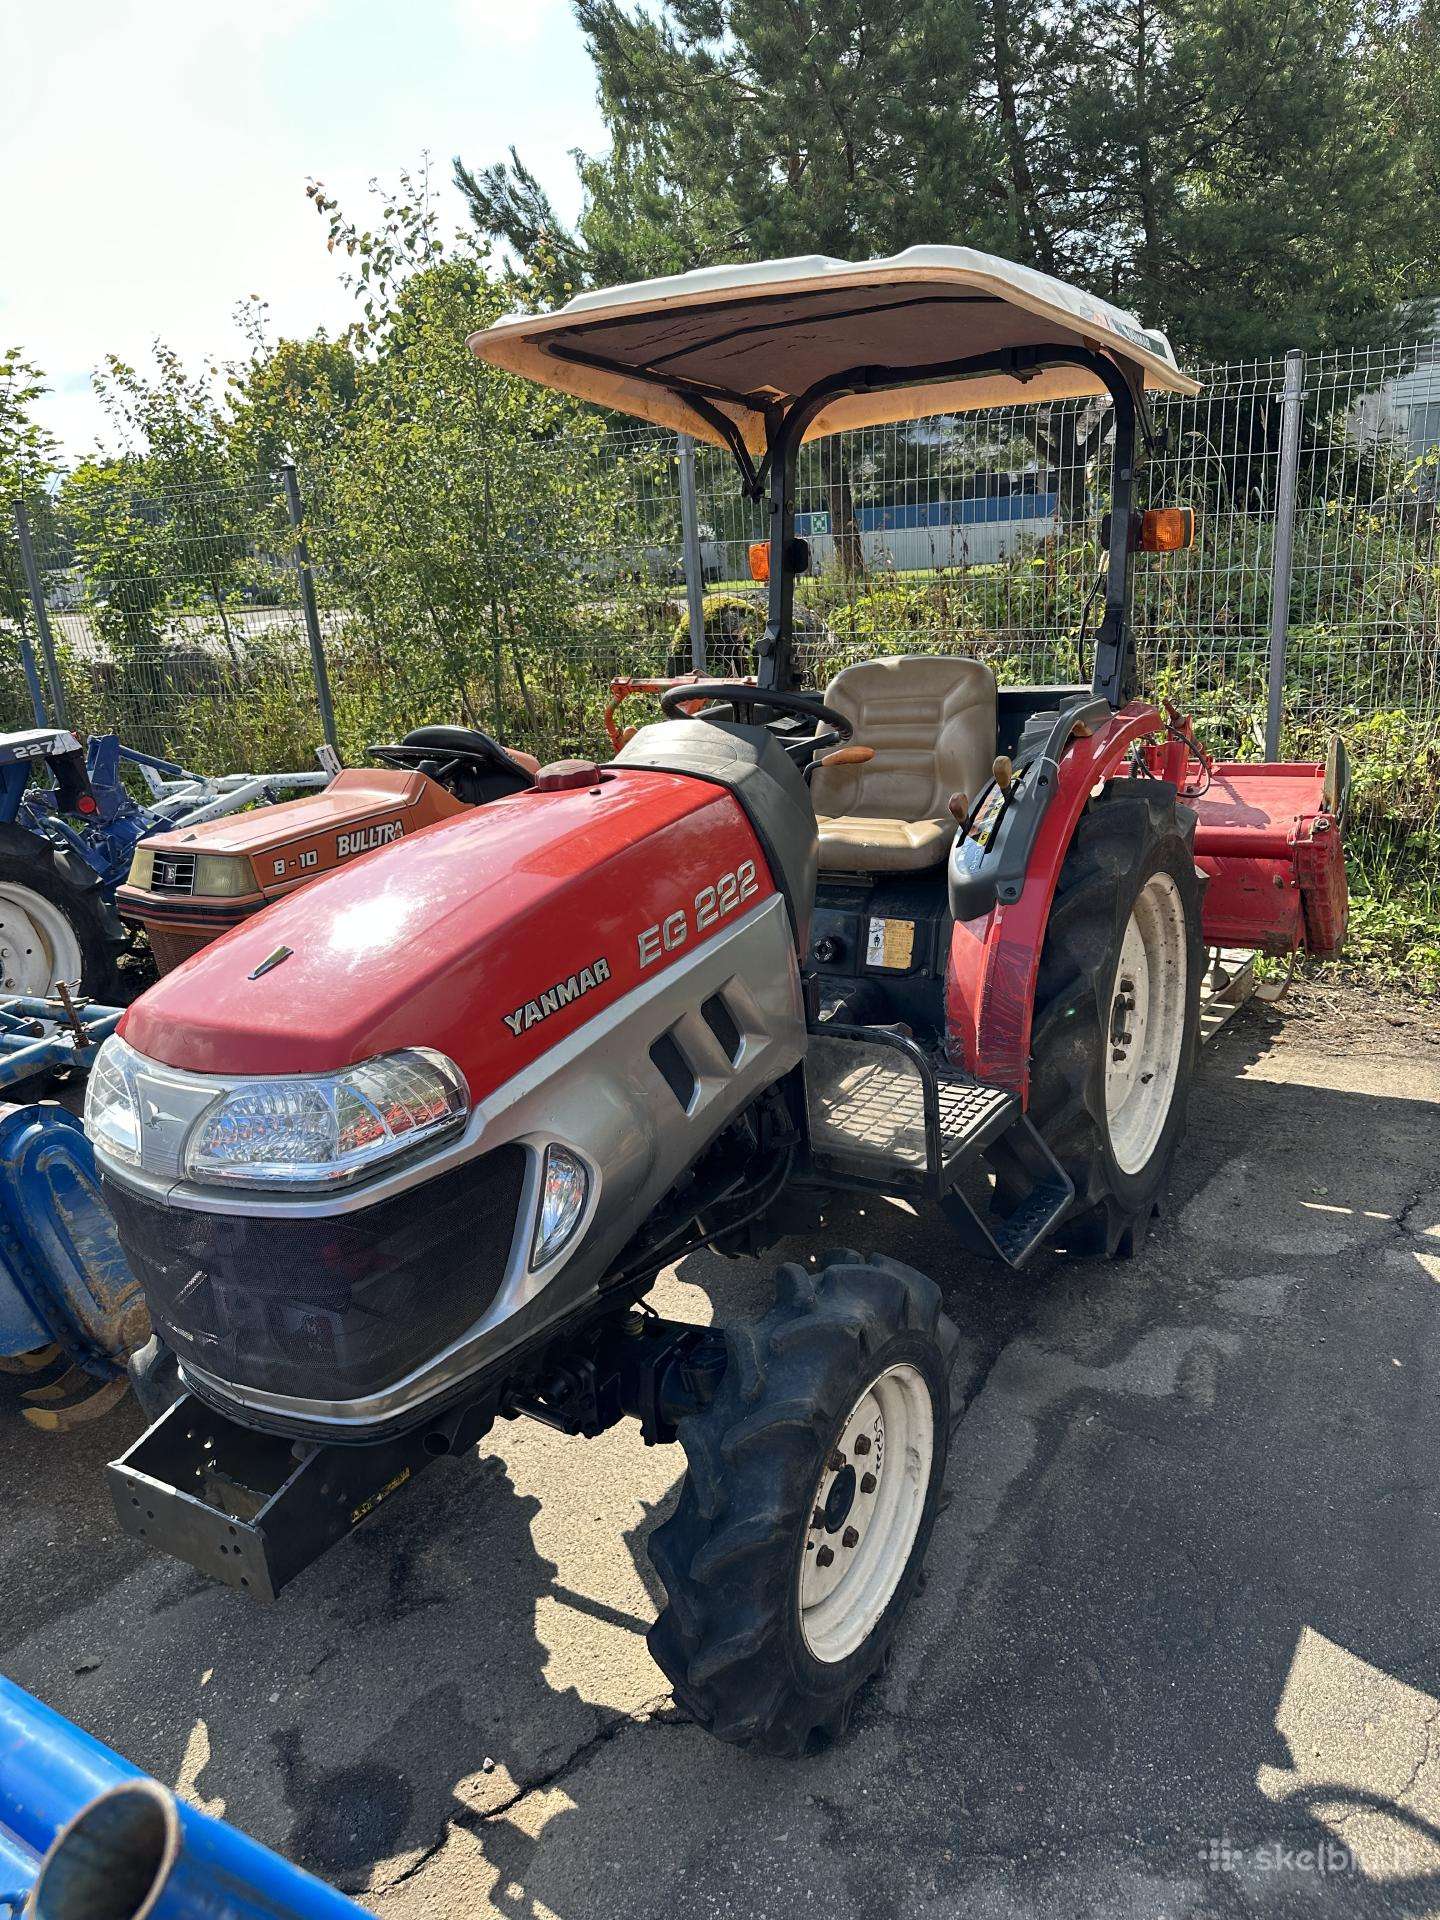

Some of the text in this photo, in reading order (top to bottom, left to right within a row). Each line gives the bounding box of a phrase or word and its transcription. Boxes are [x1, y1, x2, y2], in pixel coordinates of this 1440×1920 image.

[12, 740, 54, 759] 227
[336, 819, 404, 858] BULLTRA
[637, 859, 759, 969] EG 222
[503, 957, 611, 1036] YANMAR
